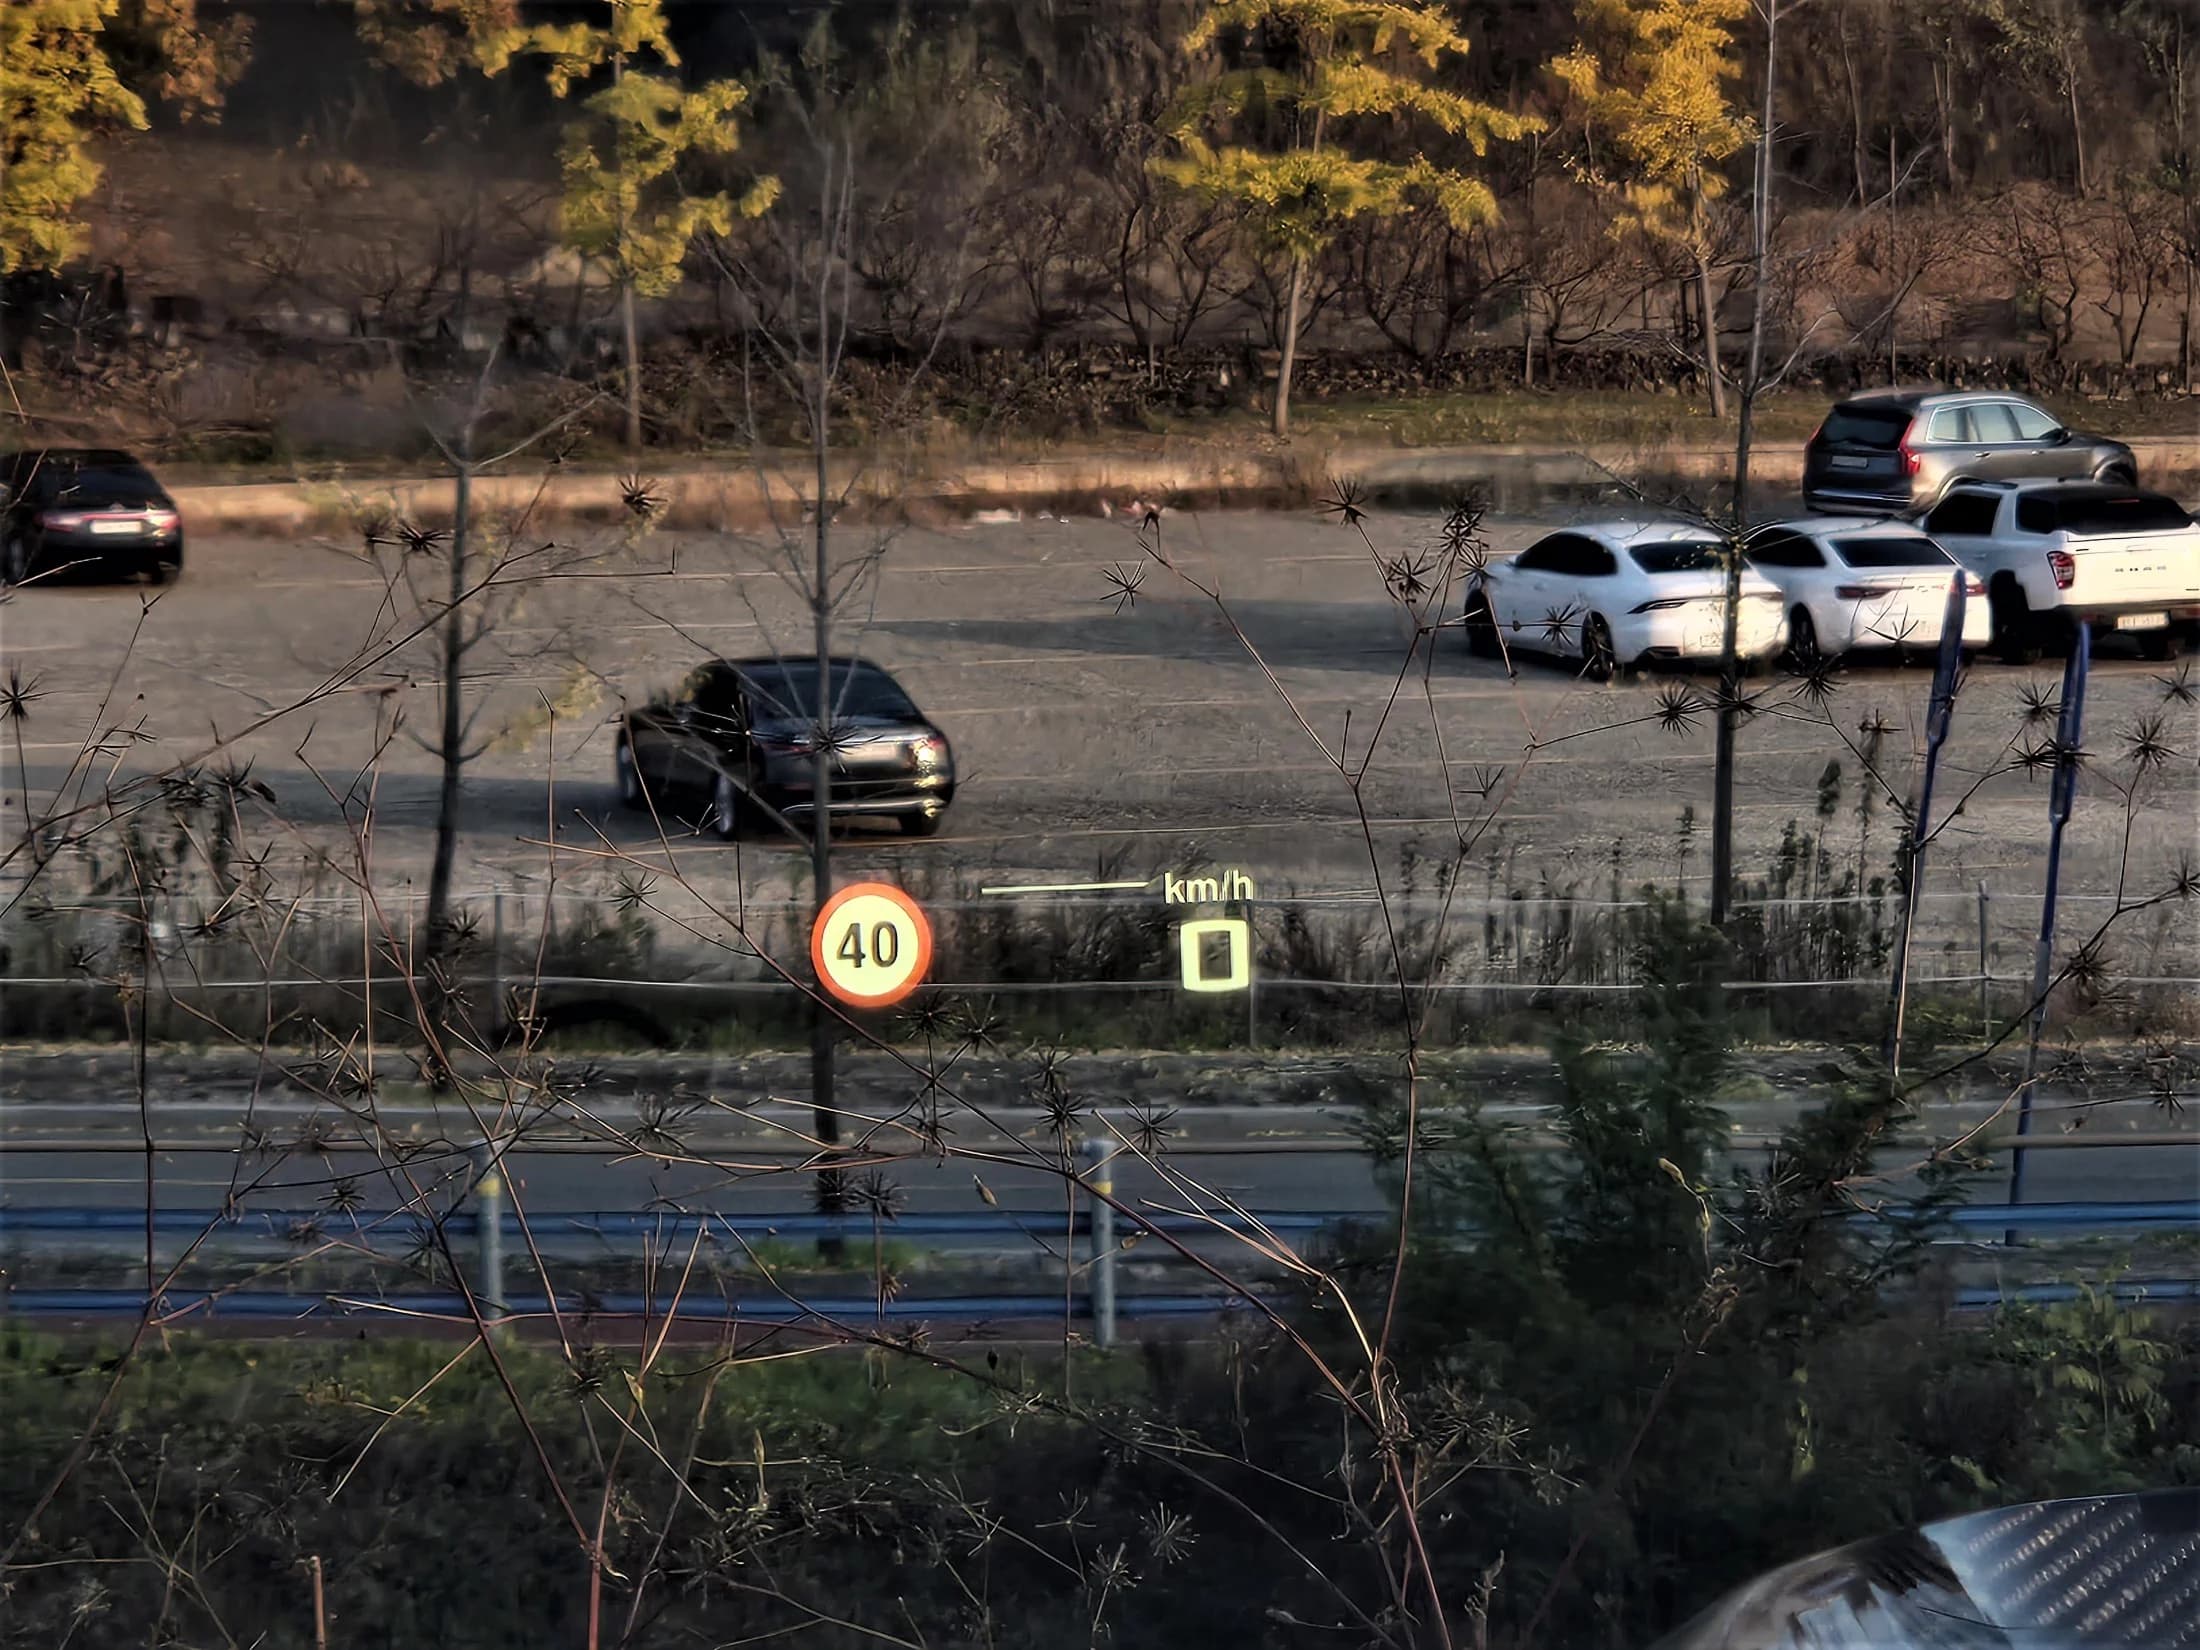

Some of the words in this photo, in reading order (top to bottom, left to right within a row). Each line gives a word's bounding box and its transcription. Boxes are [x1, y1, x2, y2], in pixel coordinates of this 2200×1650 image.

[1164, 869, 1254, 904] km/h
[836, 921, 899, 968] 40
[1180, 919, 1250, 992] 0
